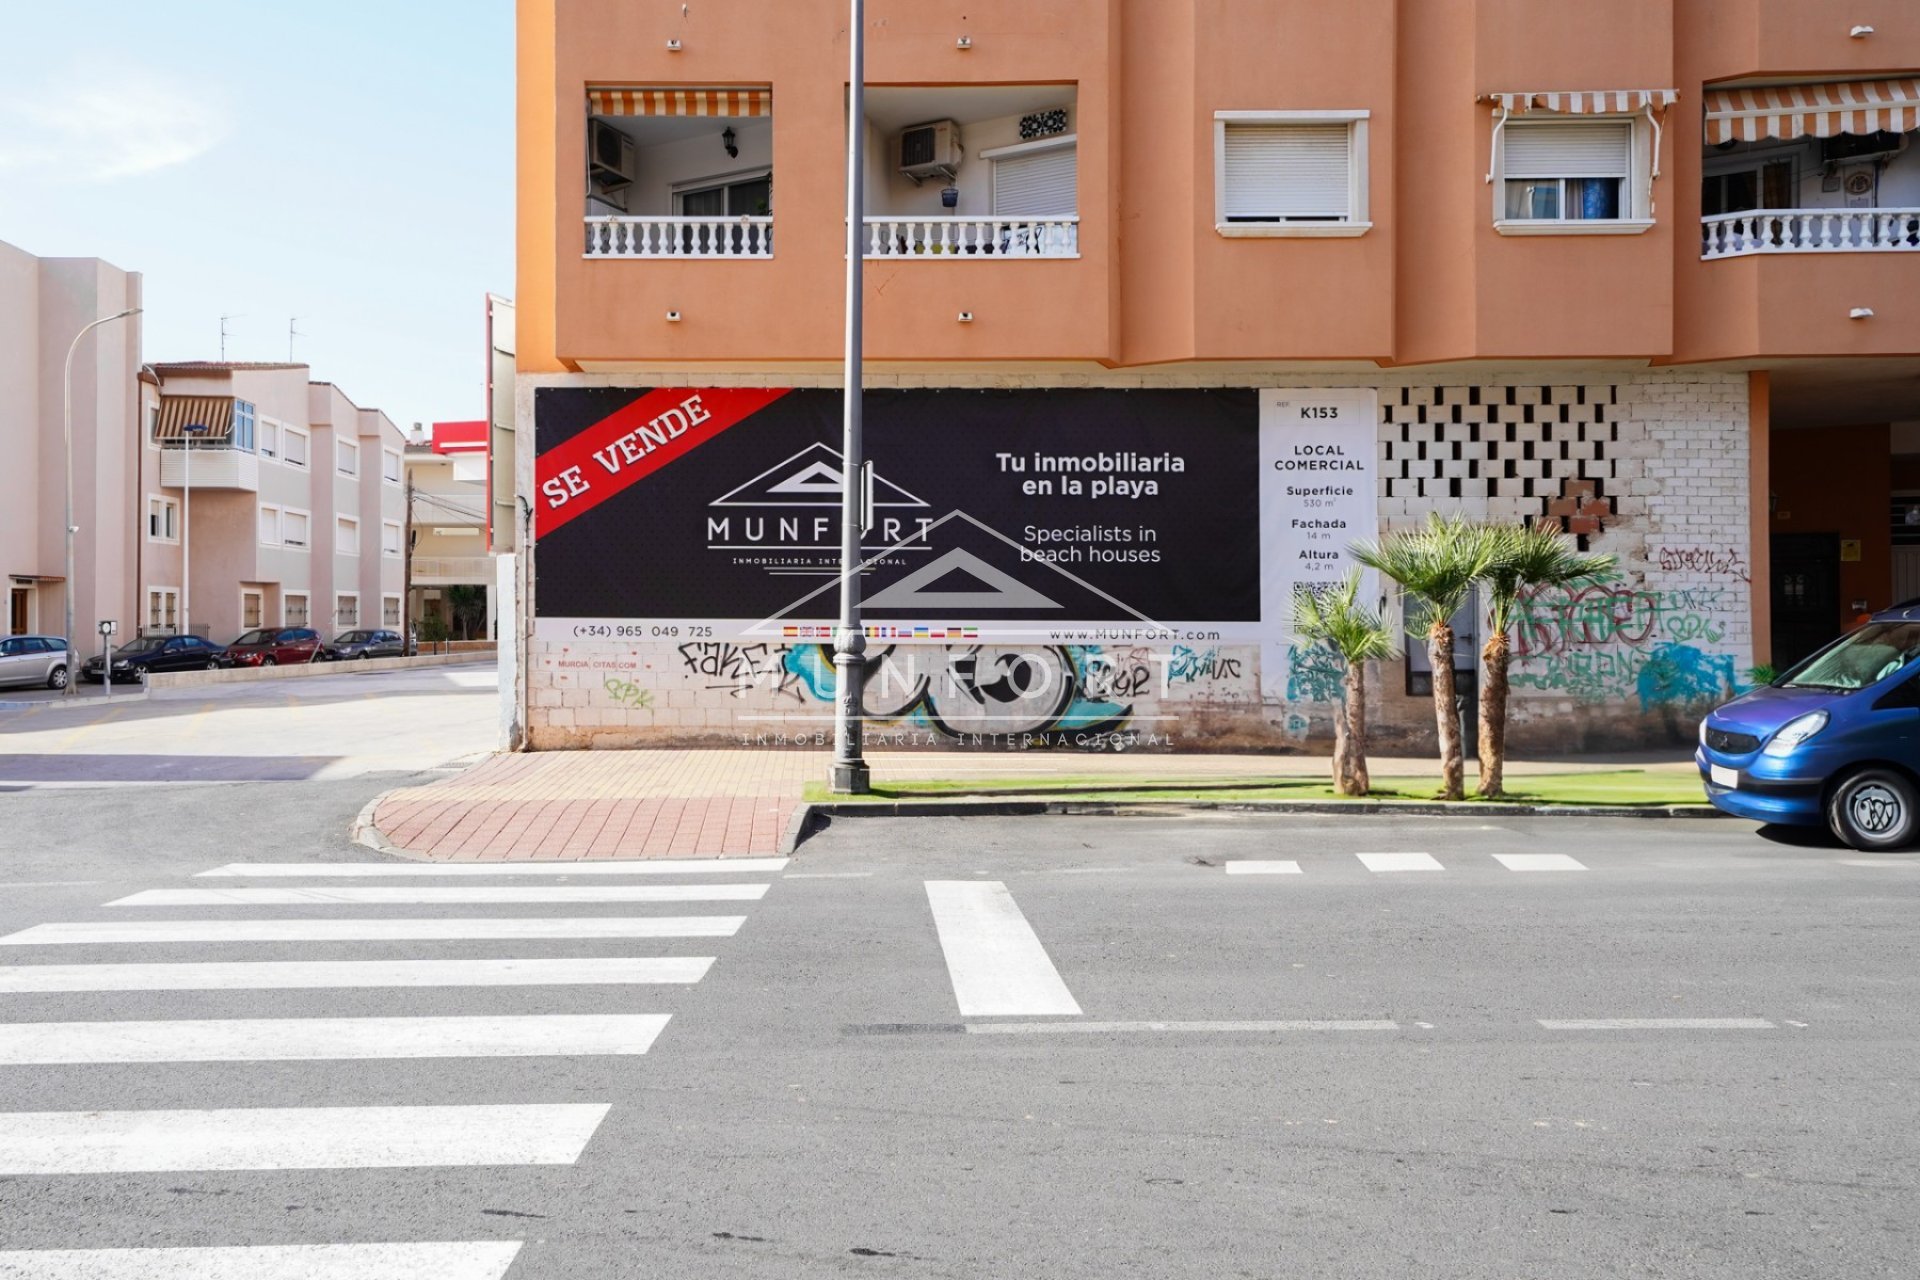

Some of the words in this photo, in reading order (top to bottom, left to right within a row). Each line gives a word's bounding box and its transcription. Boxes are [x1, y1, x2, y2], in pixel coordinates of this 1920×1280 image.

[1300, 407, 1338, 419] K153
[542, 465, 591, 509] SE
[592, 394, 711, 475] VENDE
[1294, 445, 1345, 456] LOCAL
[995, 452, 1026, 473] Tu
[1034, 452, 1186, 473] inmobiliaria
[1274, 460, 1365, 471] COMERCIAL
[1022, 478, 1053, 496] en
[1061, 475, 1083, 496] la
[1091, 475, 1159, 499] playa
[1286, 485, 1354, 498] Superficie
[1303, 499, 1322, 508] 530
[707, 517, 934, 542] MUNFRT
[1291, 518, 1347, 529] Fachada
[1023, 525, 1132, 544] Specialists
[1138, 525, 1157, 543] in
[1307, 532, 1317, 540] 14
[1020, 546, 1082, 563] beach
[1089, 546, 1161, 563] houses
[1298, 549, 1340, 560] Altura
[732, 557, 812, 566] INMOBILIARIA
[819, 557, 907, 566] INTECIONAL
[1304, 562, 1320, 571] 4,2
[573, 624, 612, 638] (+34)
[616, 625, 642, 637] 965
[651, 625, 679, 637] 049
[688, 626, 713, 638] 725
[1050, 628, 1220, 641] www.MUNFORT.com
